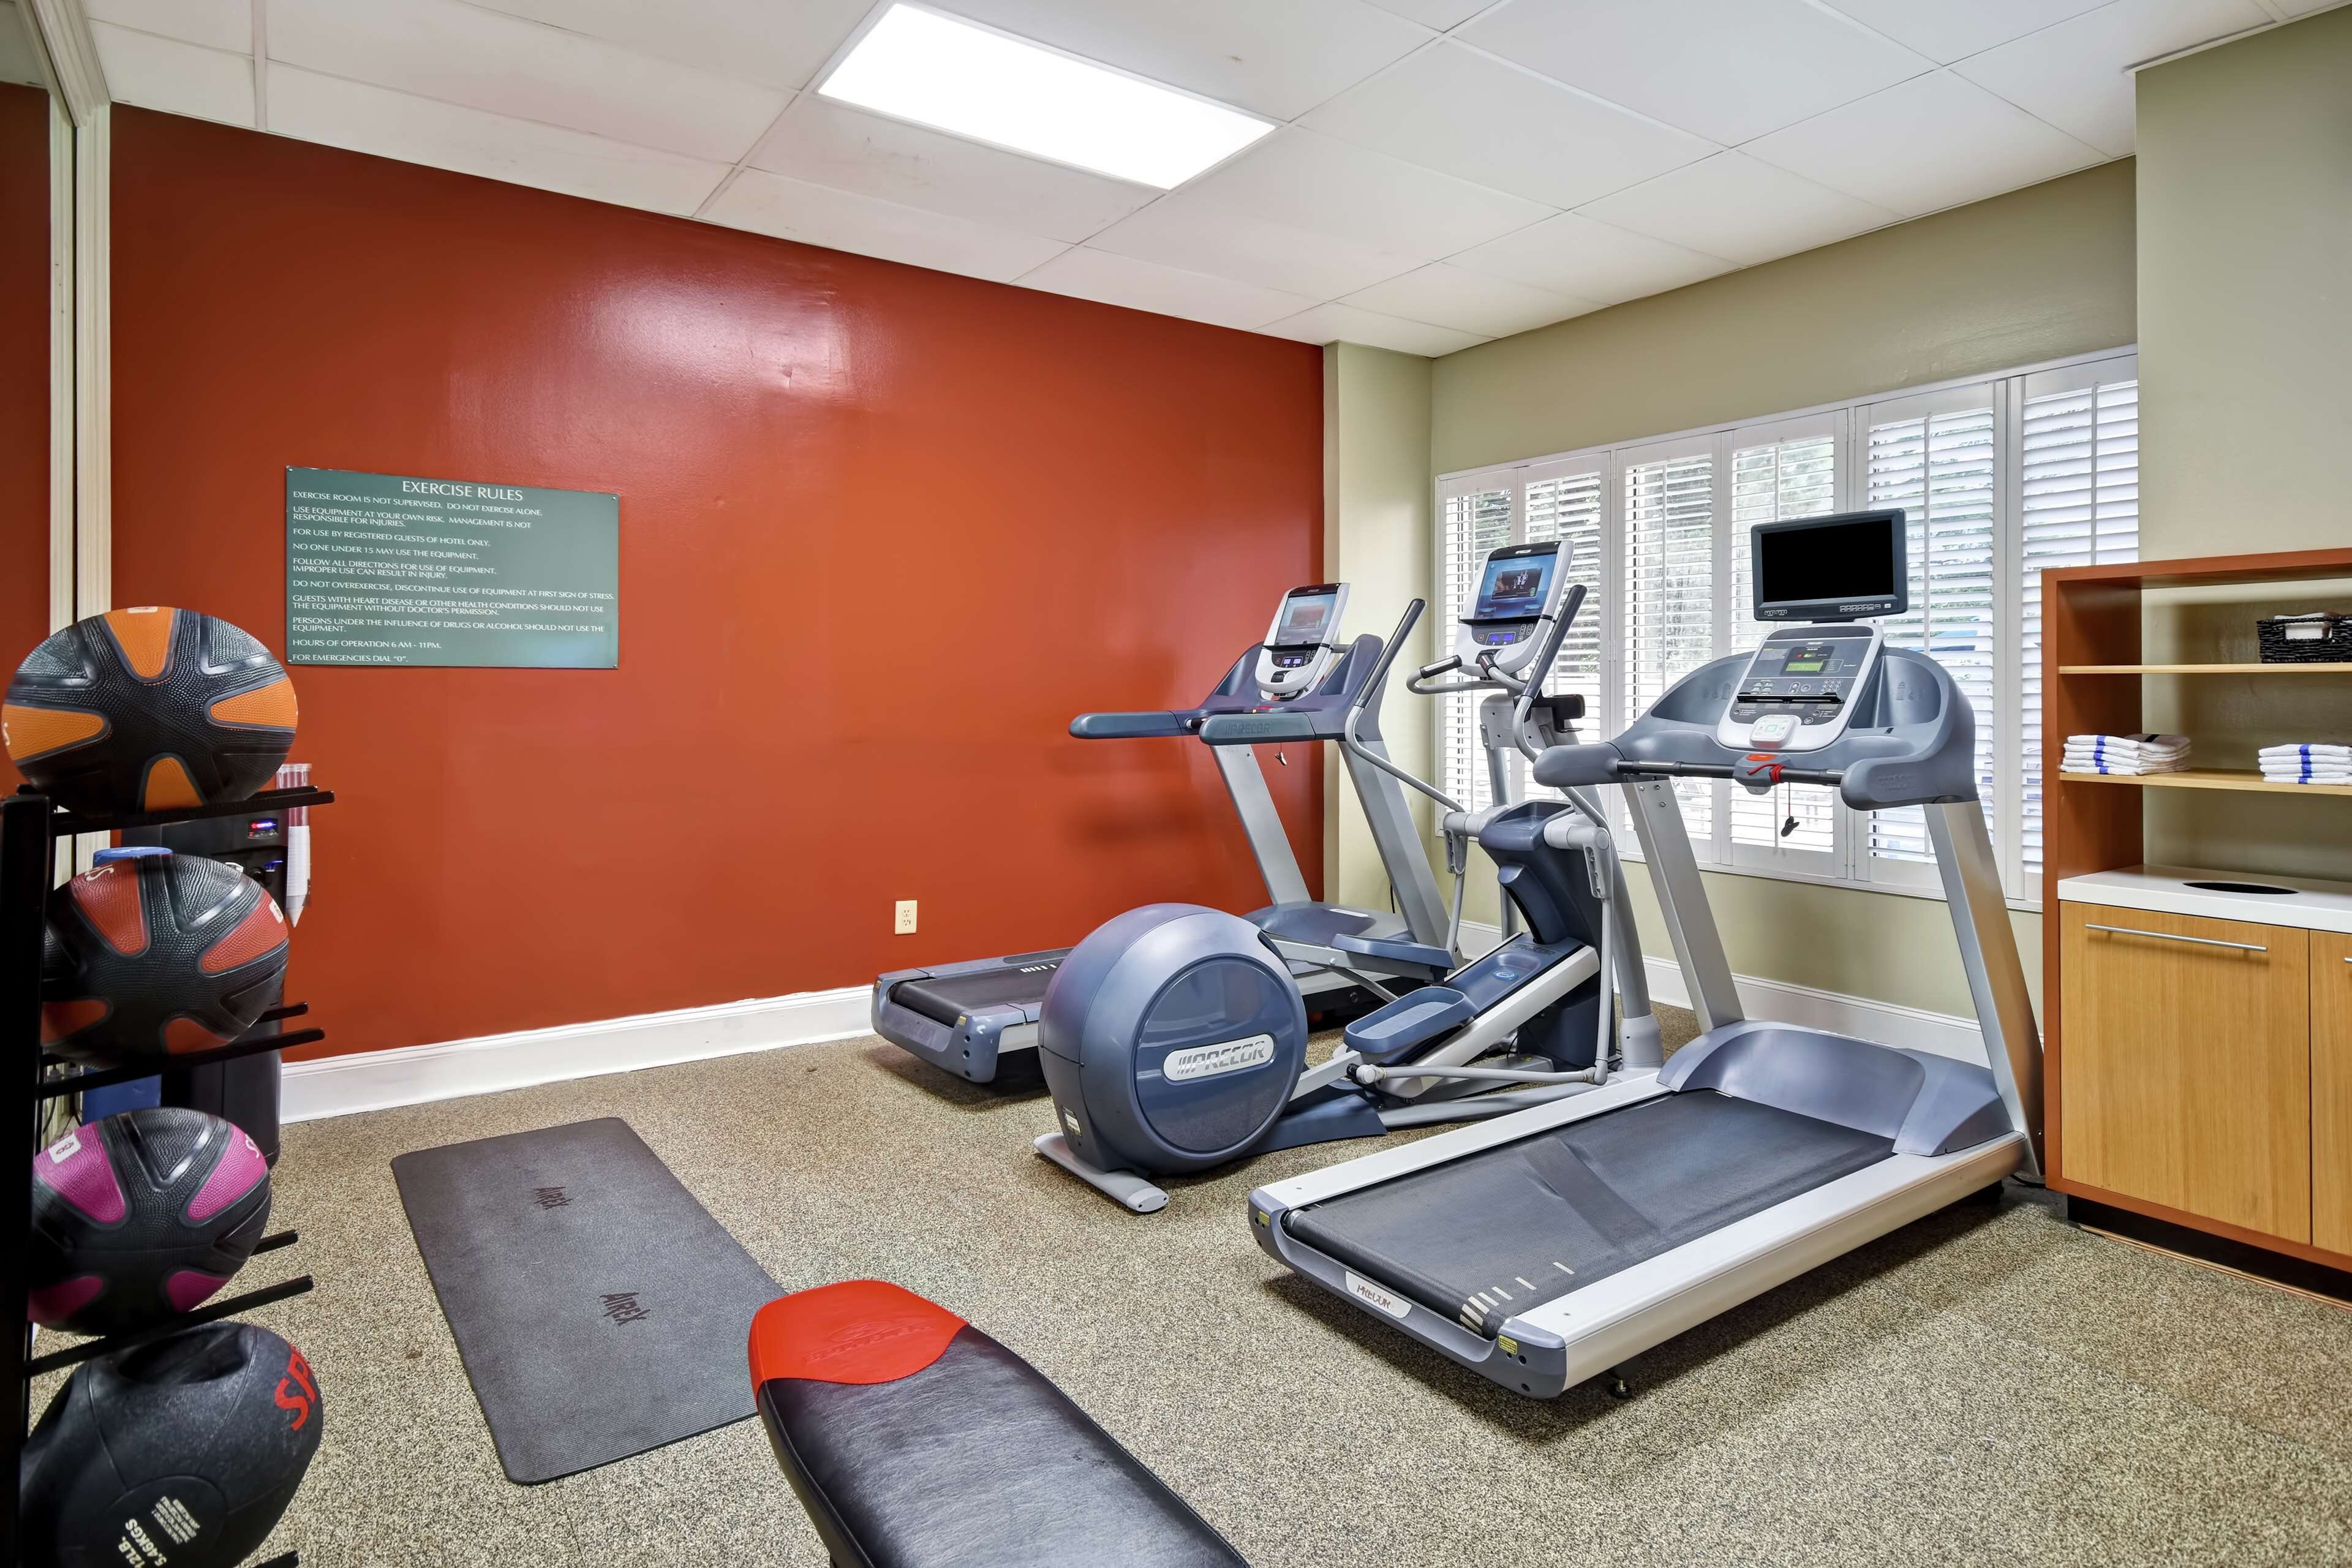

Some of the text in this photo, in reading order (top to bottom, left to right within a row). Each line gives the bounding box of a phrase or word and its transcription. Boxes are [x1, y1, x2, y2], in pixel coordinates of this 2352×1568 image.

[293, 491, 331, 500] EXERCISE
[393, 499, 443, 509] SUPERVISED.
[403, 481, 523, 501] EXERCISE RULES
[293, 514, 349, 522] RESPONSIBLE
[370, 519, 406, 527] INJURIES.
[312, 507, 363, 517] EQUIPMENT
[449, 518, 505, 527] MANAGEMENT
[344, 532, 393, 540] REGISTERED
[331, 545, 363, 554] UNDER
[431, 551, 479, 560] EQUIPMENT.
[449, 566, 497, 575] EQUIPMENT.
[395, 584, 451, 594] DISCONTINUE
[1190, 1041, 1265, 1073] PRECOR
[599, 1292, 650, 1326] AIREX
[125, 1518, 167, 1567] 5.46KGS
